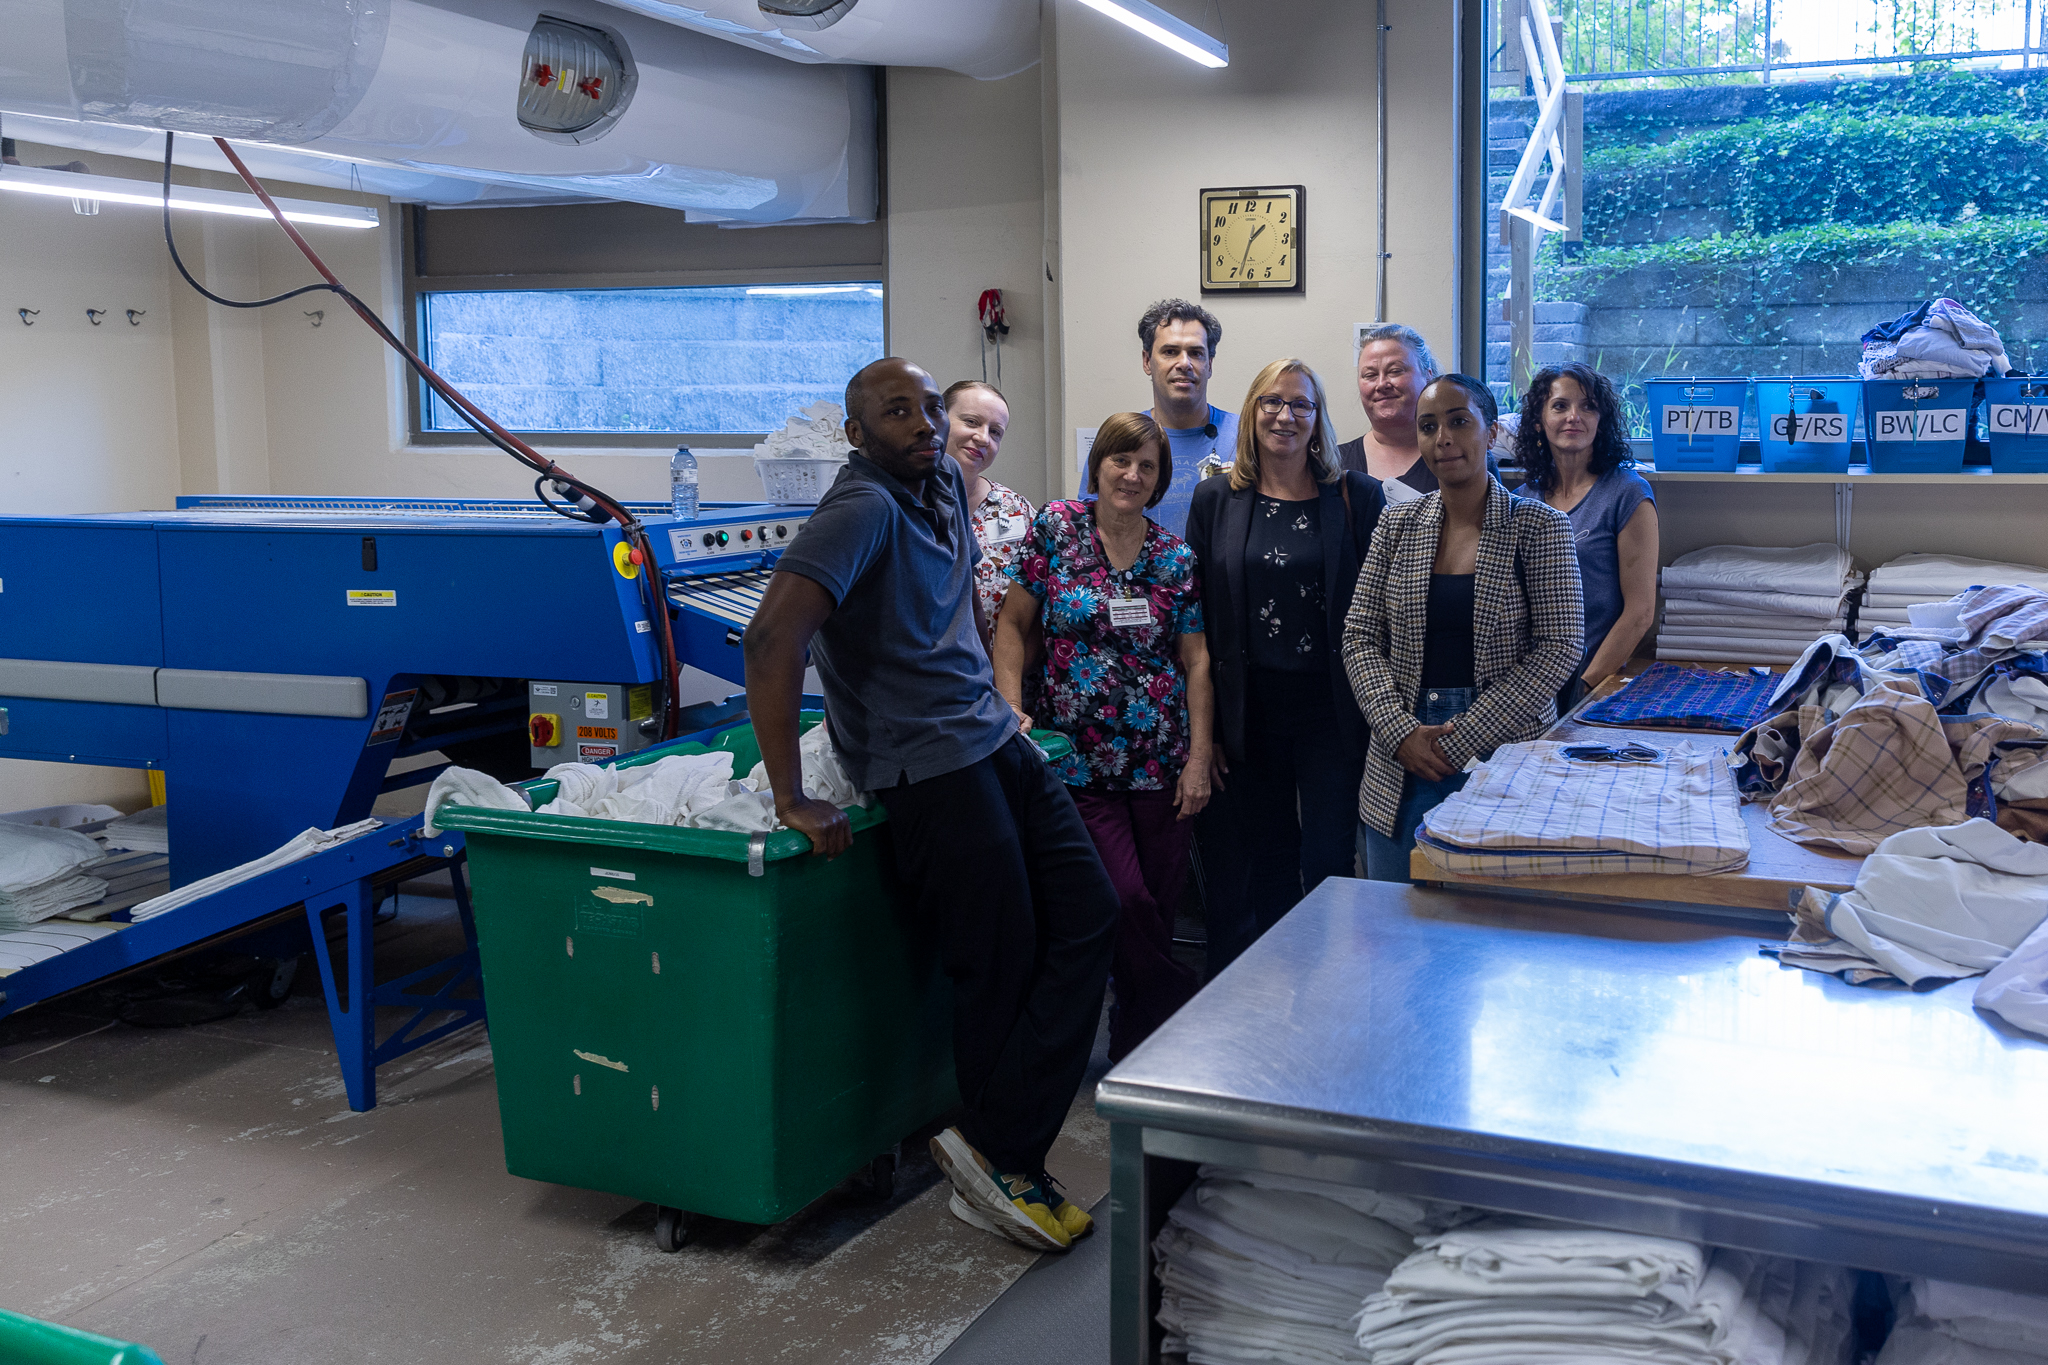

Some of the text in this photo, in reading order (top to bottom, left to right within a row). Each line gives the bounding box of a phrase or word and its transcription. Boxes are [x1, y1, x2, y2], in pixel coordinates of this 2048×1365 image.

[1228, 202, 1238, 214] 11
[1244, 200, 1256, 212] 12
[1266, 201, 1272, 213] 1
[1215, 216, 1226, 228] 10
[1278, 212, 1287, 223] 2
[1213, 234, 1221, 246] 9
[1282, 233, 1289, 244] 3
[1216, 255, 1224, 266] 8
[1278, 254, 1287, 265] 4
[1229, 267, 1238, 278] 7
[1246, 268, 1254, 280] 6
[1264, 267, 1272, 278] 5
[1881, 414, 1959, 438] BW/LC
[1996, 408, 2048, 432] CM/
[579, 725, 616, 739] 208 VOLTS
